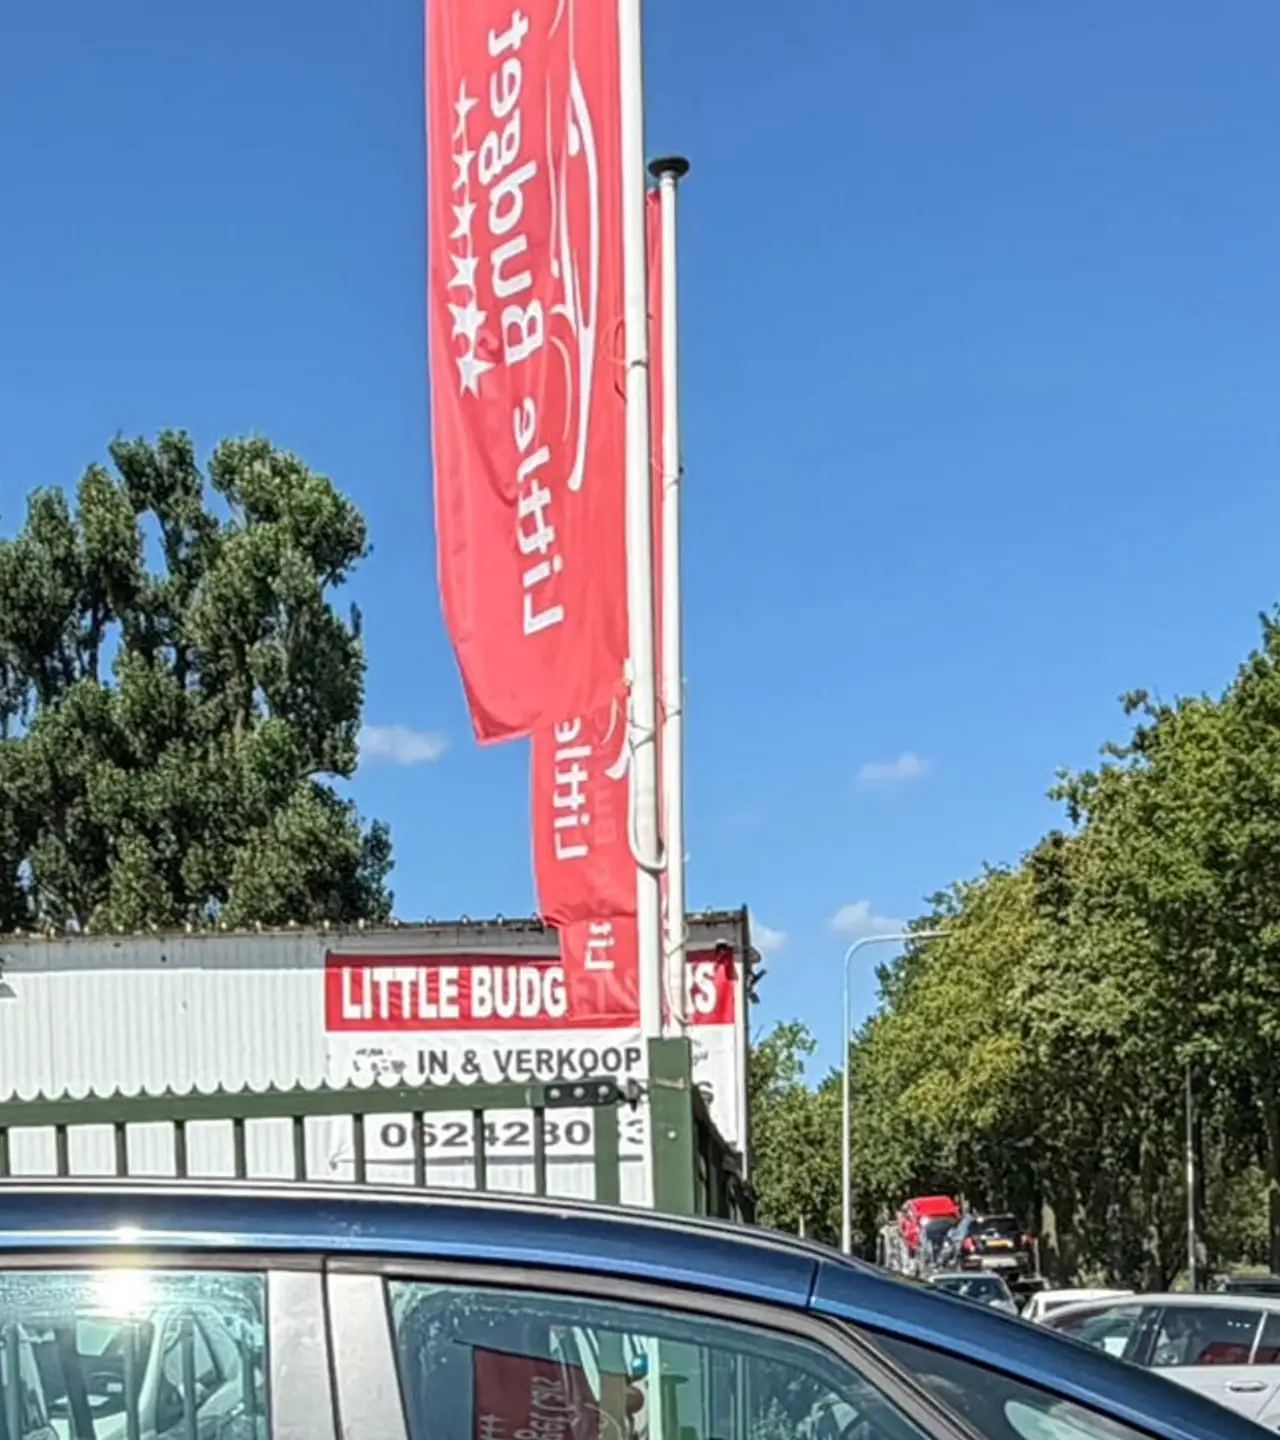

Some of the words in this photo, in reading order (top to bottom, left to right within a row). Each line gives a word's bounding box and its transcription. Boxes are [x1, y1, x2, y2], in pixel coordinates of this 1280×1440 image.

[341, 965, 458, 1019] LITTLE
[471, 965, 569, 1018] BUDG
[417, 1050, 448, 1075] IN
[460, 1049, 480, 1075] &
[494, 1047, 642, 1075] VERKOOP
